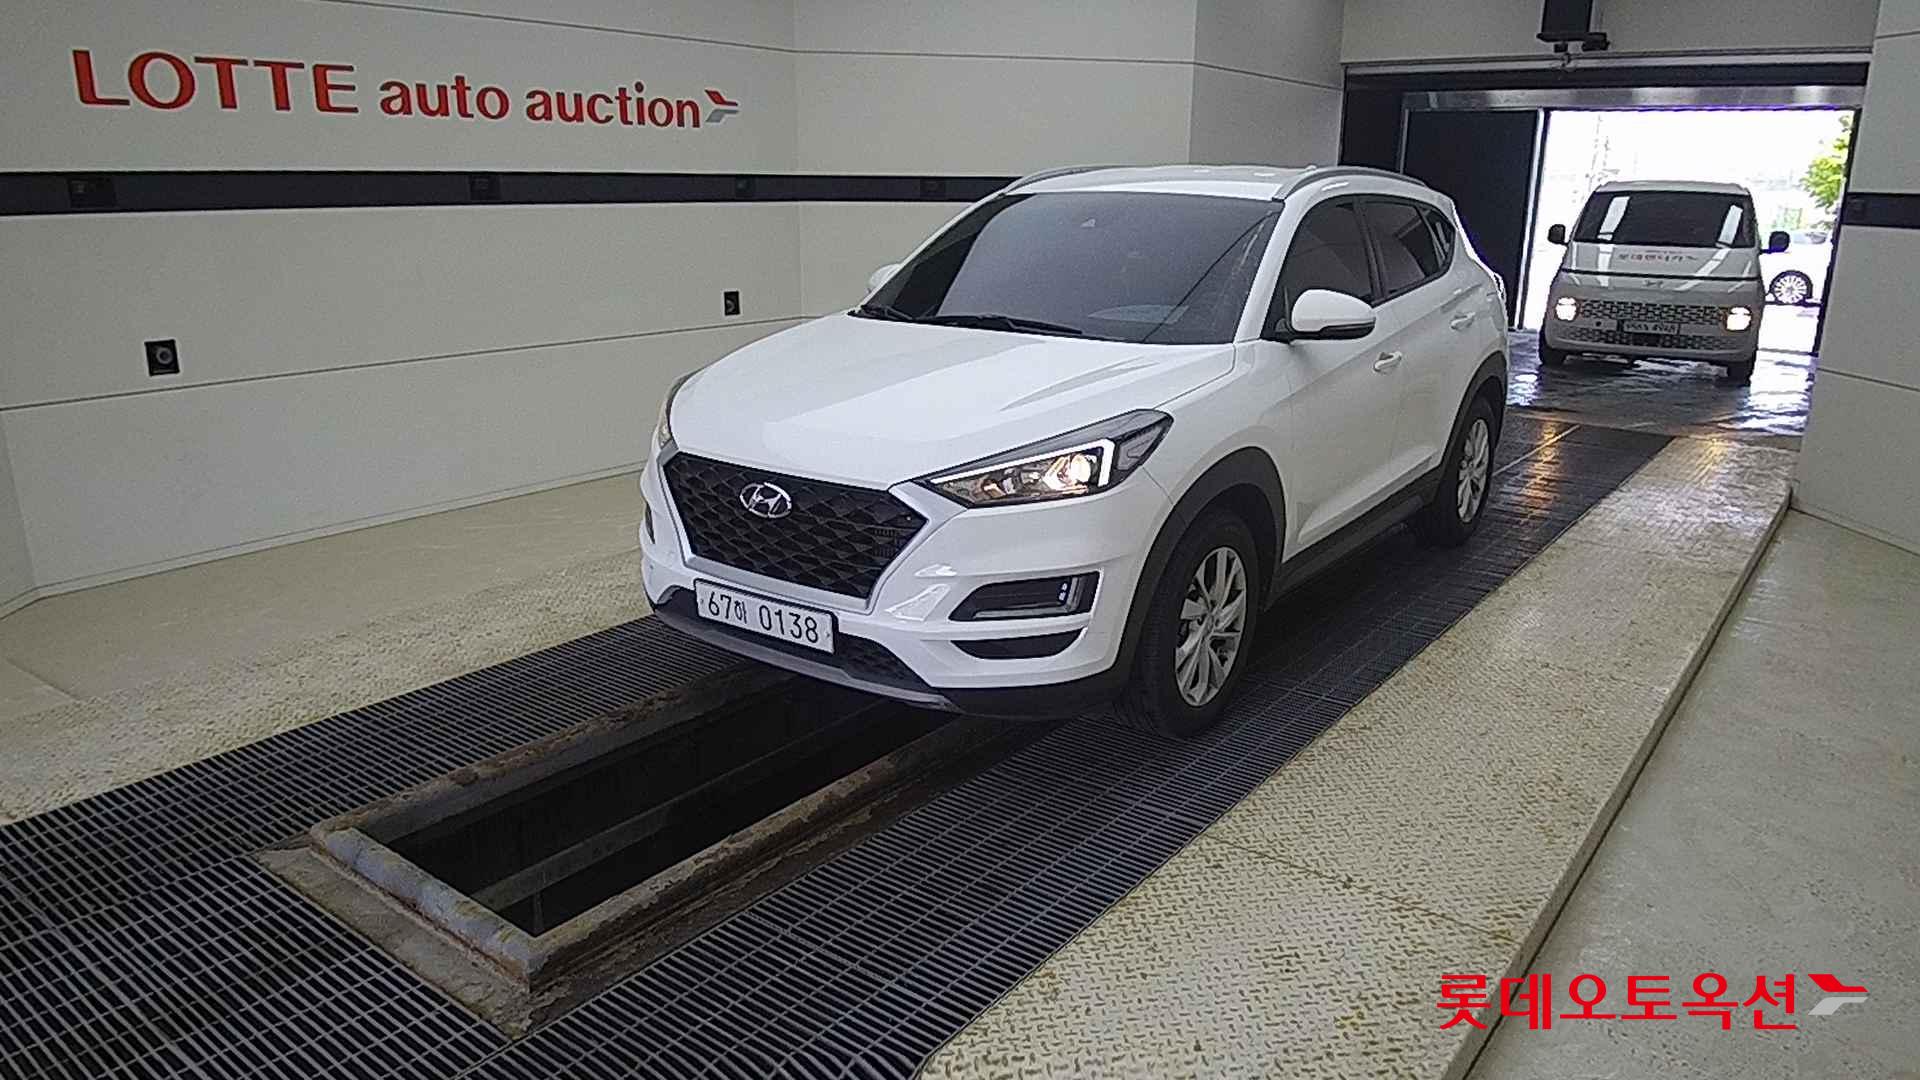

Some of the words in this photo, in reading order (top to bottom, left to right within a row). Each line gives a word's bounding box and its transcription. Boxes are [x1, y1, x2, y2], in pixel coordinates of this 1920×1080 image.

[71, 50, 356, 113] LOTTE
[380, 75, 511, 120] auto
[526, 82, 702, 127] auction
[758, 604, 819, 644] 0138
